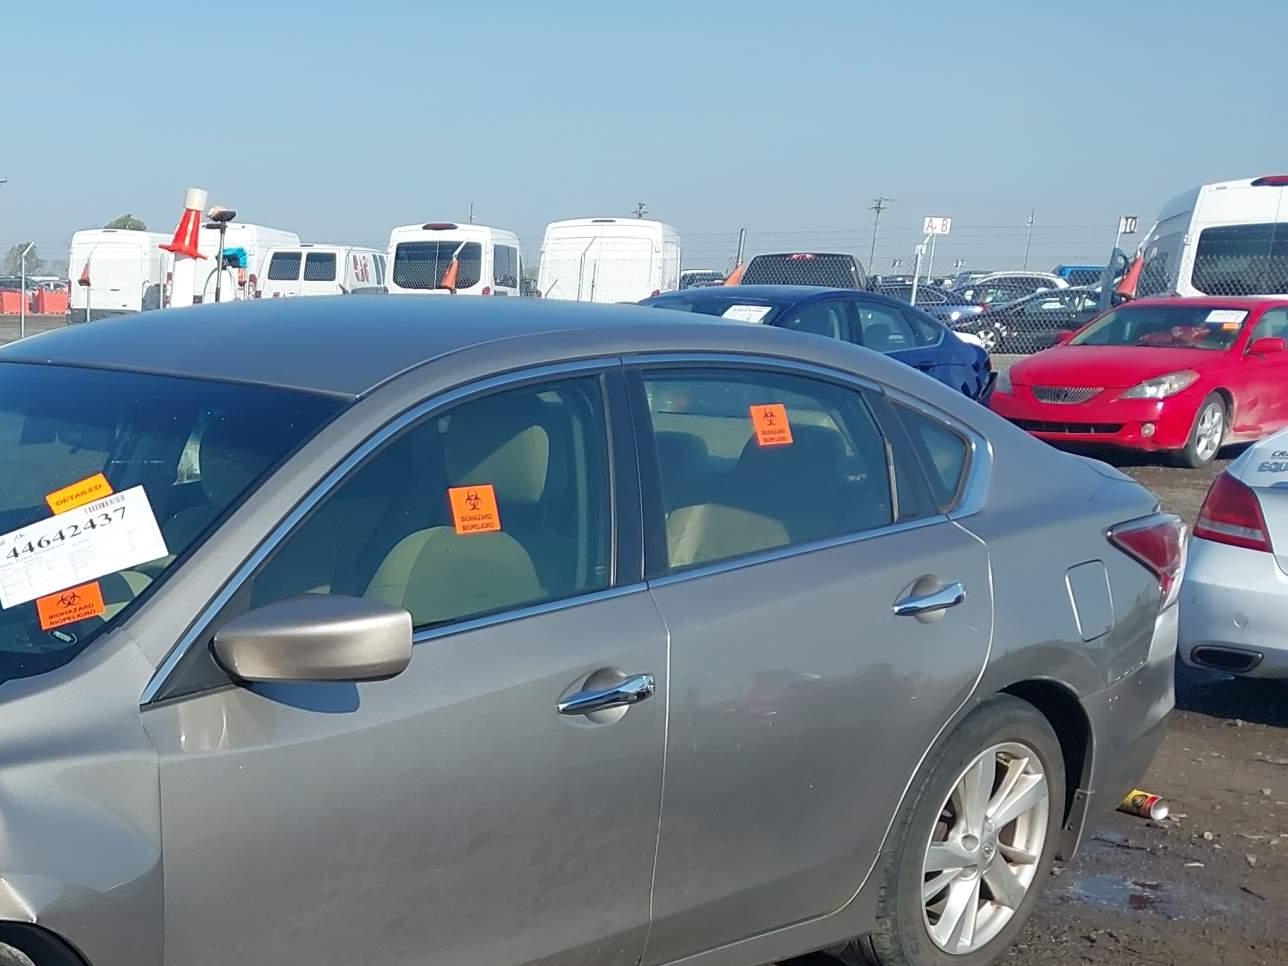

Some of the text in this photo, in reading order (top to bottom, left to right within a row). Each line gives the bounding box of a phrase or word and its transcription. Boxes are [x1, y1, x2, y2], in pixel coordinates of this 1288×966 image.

[6, 506, 126, 560] 44642437
[48, 602, 94, 620] BIOHAZARD
[49, 609, 96, 626] BIOPELIGRO
